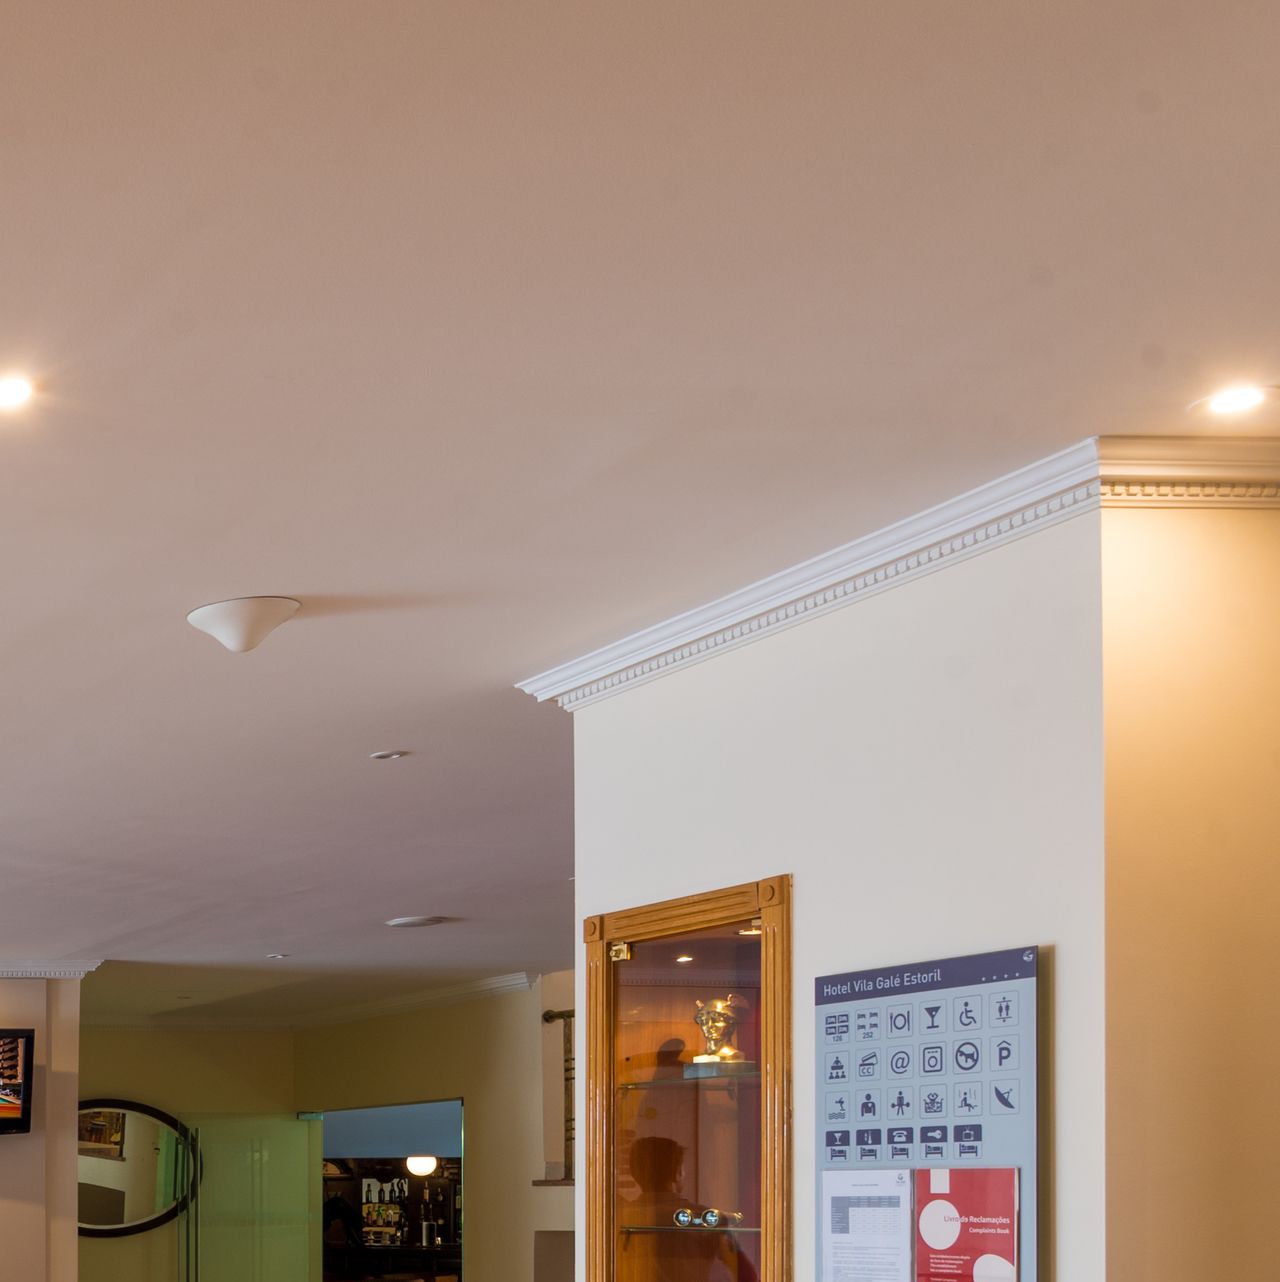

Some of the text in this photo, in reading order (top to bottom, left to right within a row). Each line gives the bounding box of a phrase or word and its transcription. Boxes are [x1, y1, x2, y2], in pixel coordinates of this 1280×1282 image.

[823, 968, 942, 996] Hotel Vila Galé Estoril
[969, 1215, 1010, 1225] Reclamações
